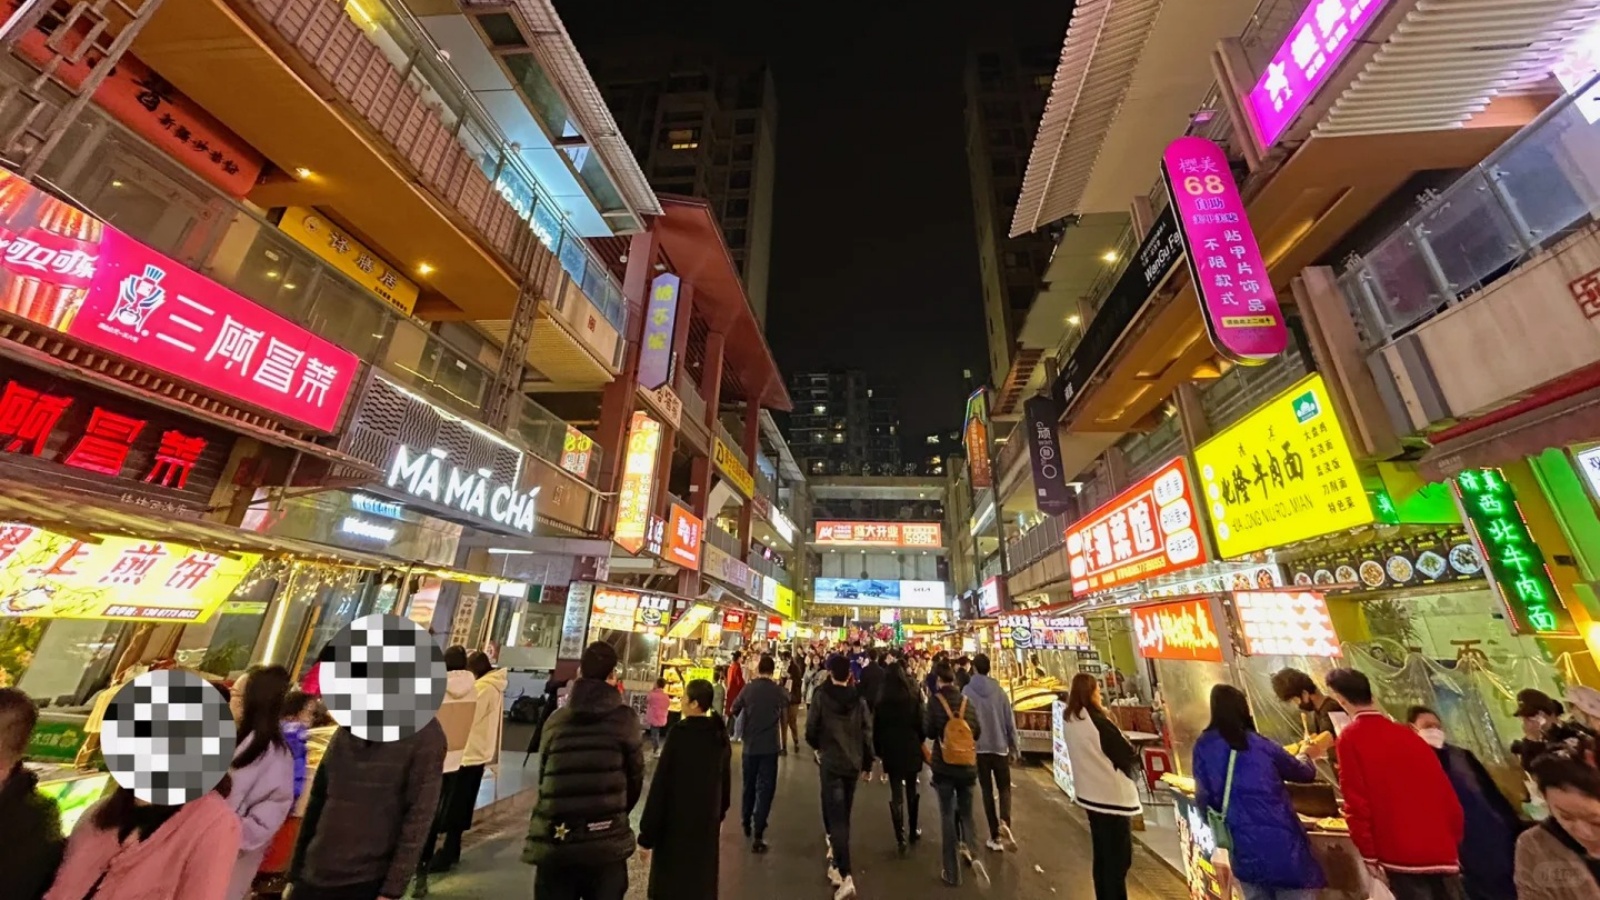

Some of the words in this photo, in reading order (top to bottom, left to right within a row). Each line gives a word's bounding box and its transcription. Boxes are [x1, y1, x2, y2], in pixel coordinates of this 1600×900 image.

[1183, 175, 1225, 195] 68
[5, 237, 100, 279] 可口可乐
[1203, 237, 1239, 307] 不限款式
[1223, 229, 1267, 312] 贴甲片饰品
[156, 293, 339, 408] 三顾冒菜
[1479, 494, 1556, 631] 西北牛肉面
